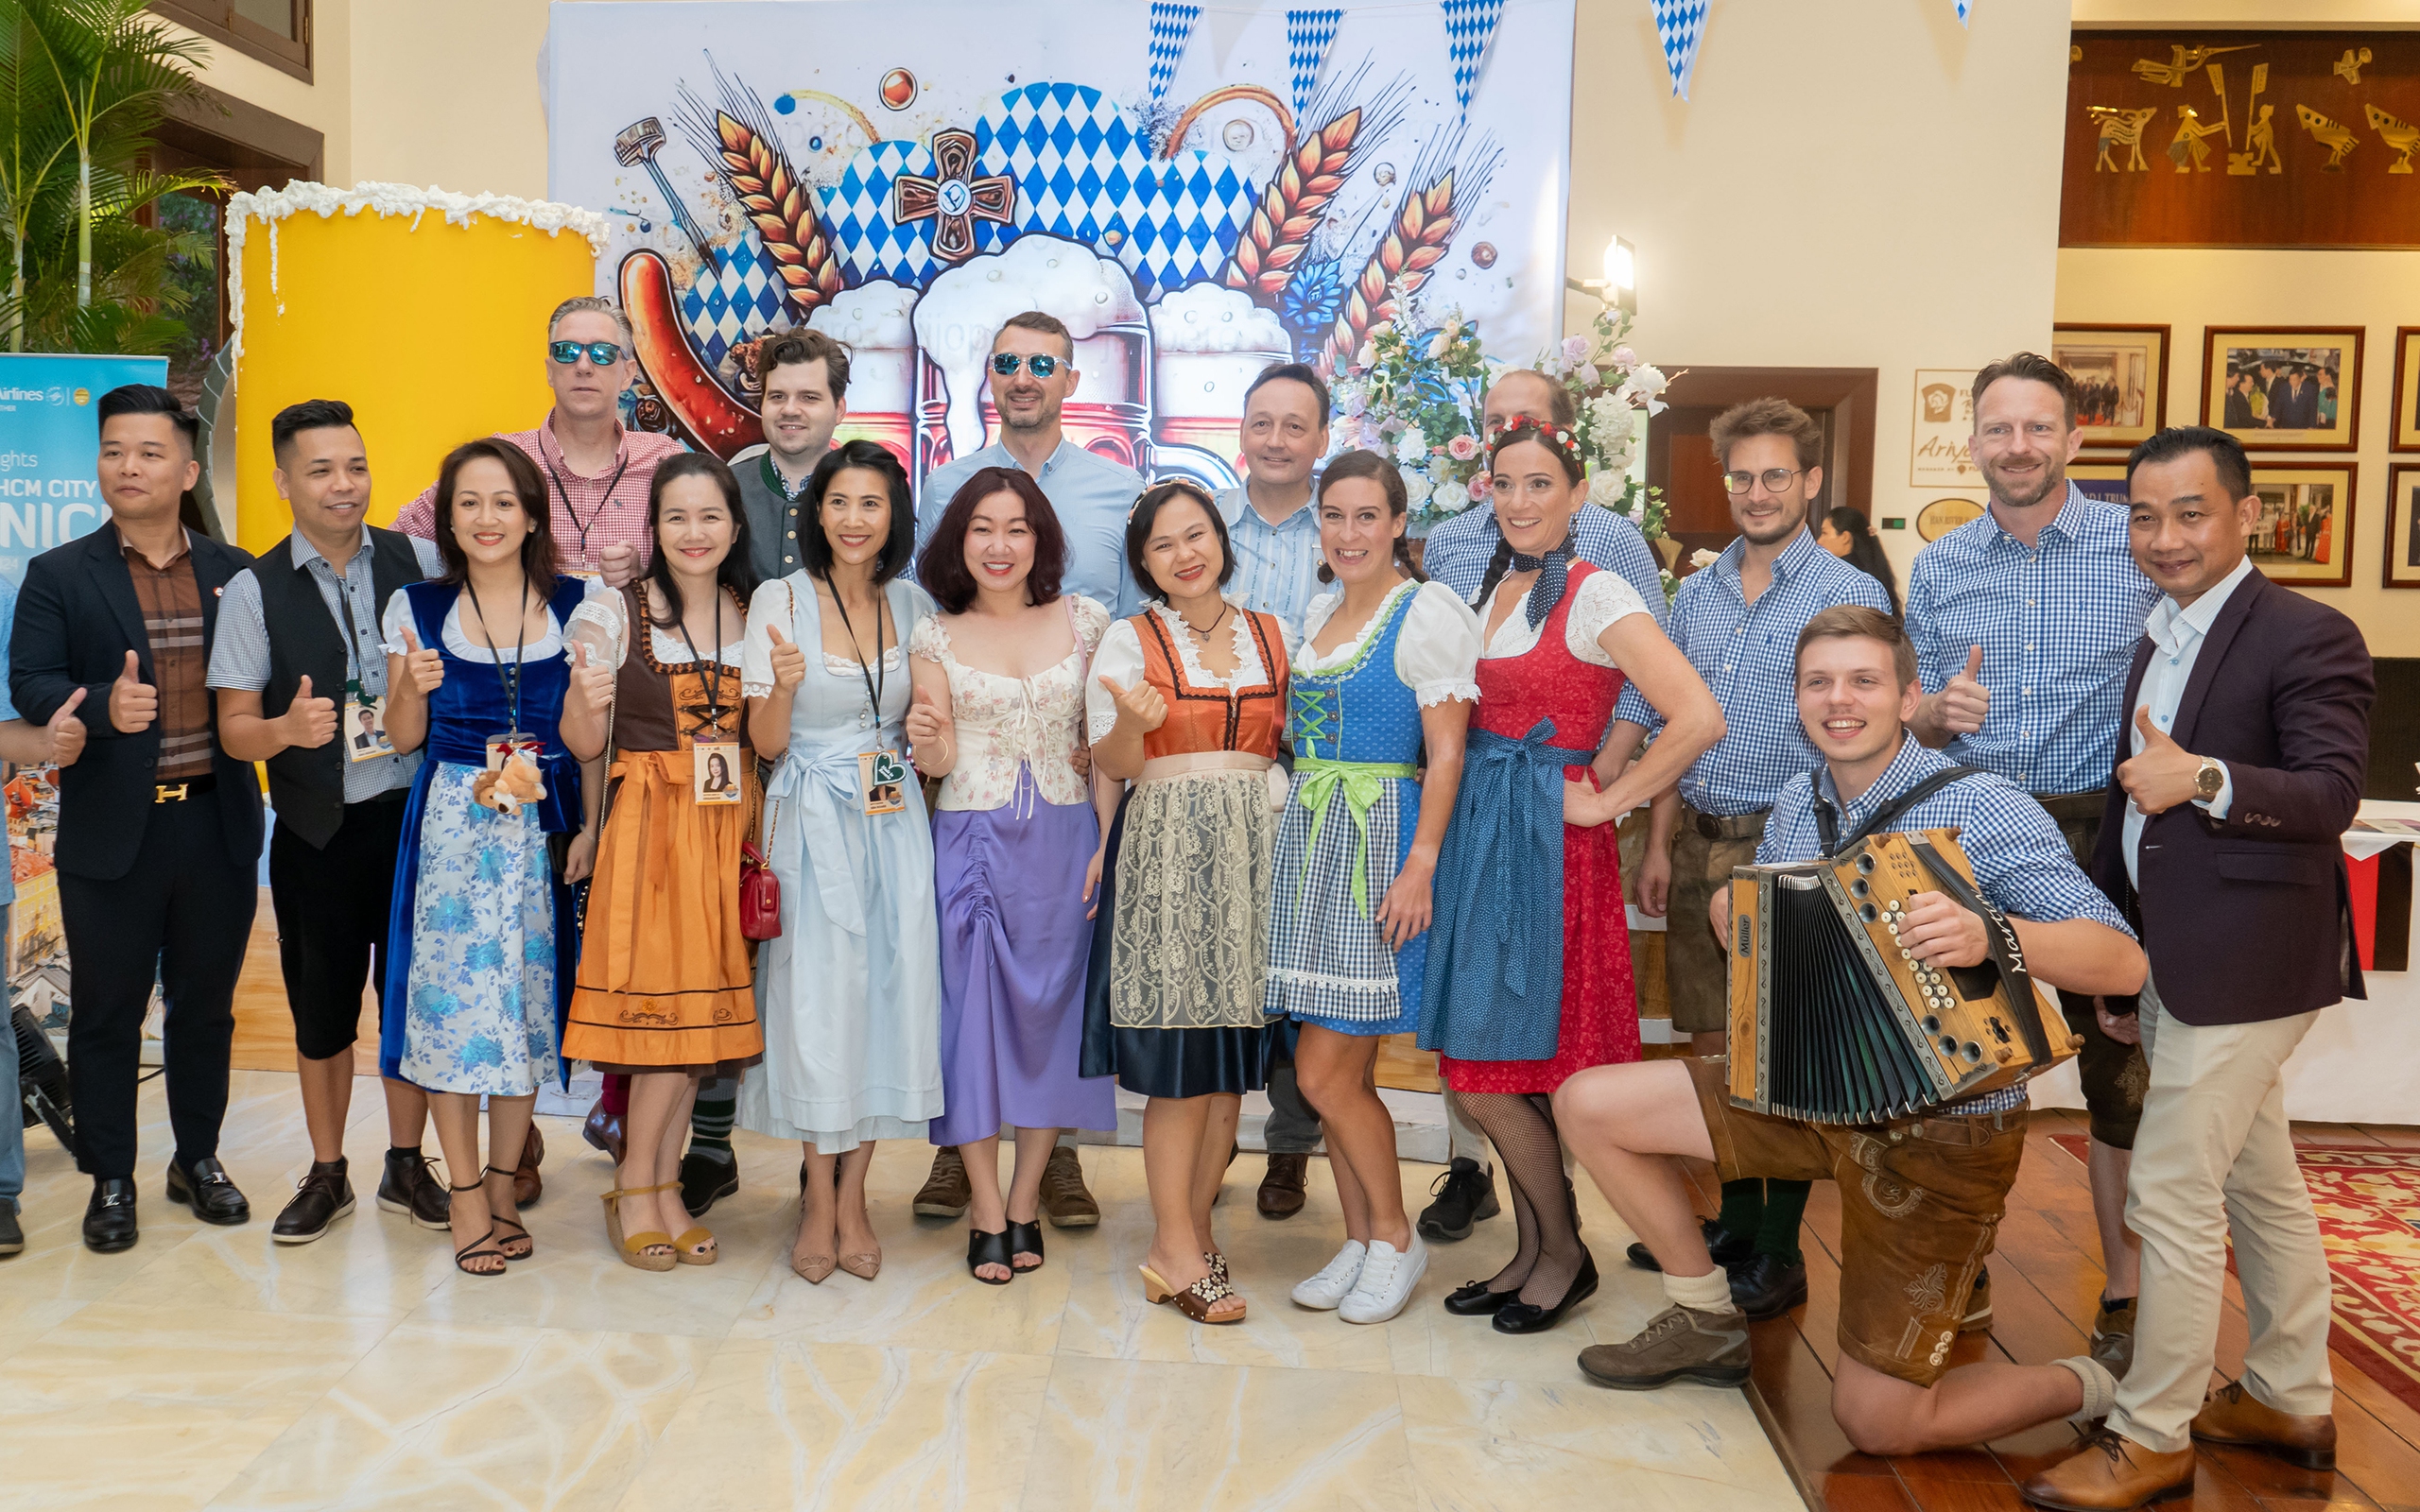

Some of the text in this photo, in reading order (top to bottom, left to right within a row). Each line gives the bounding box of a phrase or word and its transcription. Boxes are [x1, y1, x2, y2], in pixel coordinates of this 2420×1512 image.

[48, 479, 97, 498] CITY
[1740, 918, 1750, 954] Müller
[1970, 888, 2027, 972] Martin
